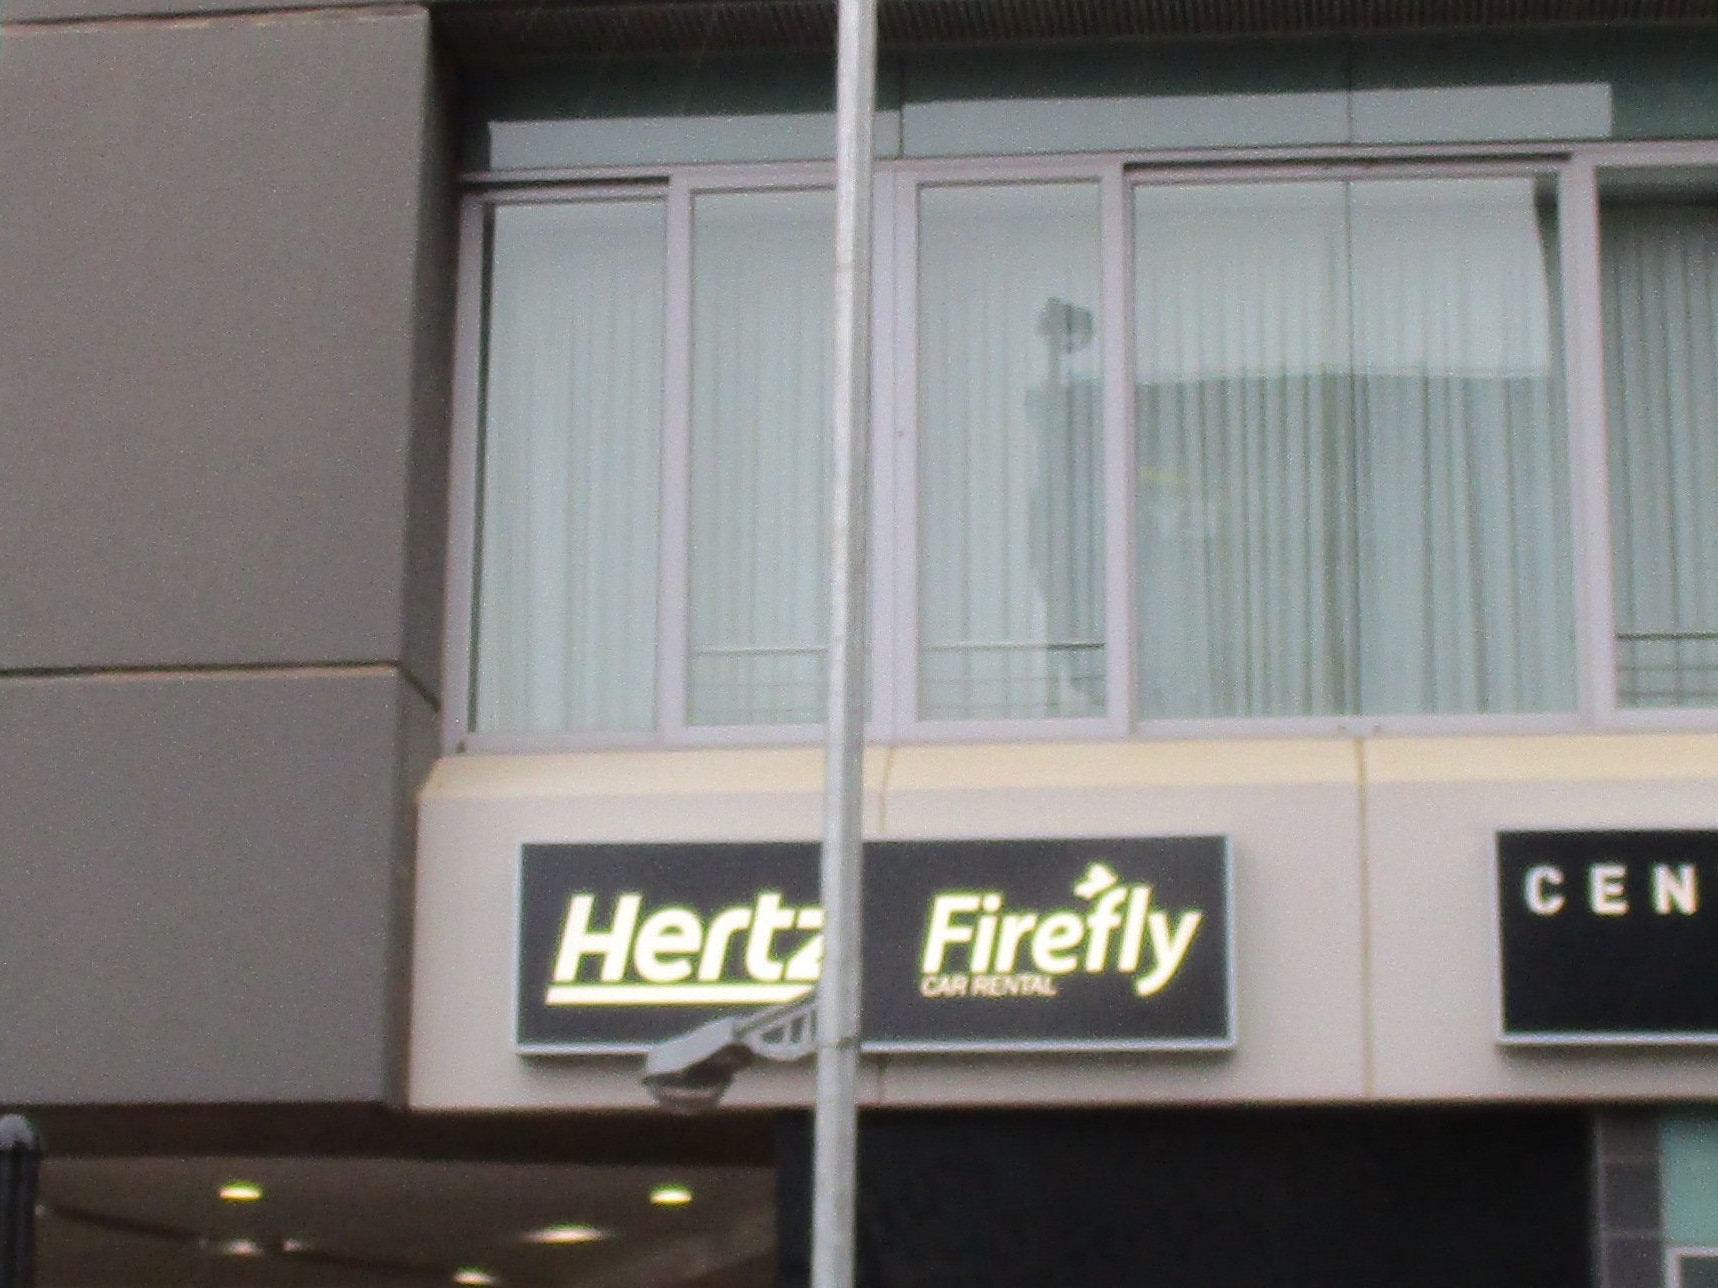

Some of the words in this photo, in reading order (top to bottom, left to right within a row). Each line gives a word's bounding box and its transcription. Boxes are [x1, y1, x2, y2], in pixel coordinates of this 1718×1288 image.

[921, 878, 1203, 998] Firefly
[919, 973, 969, 999] CAR
[970, 972, 1059, 999] RENTAL
